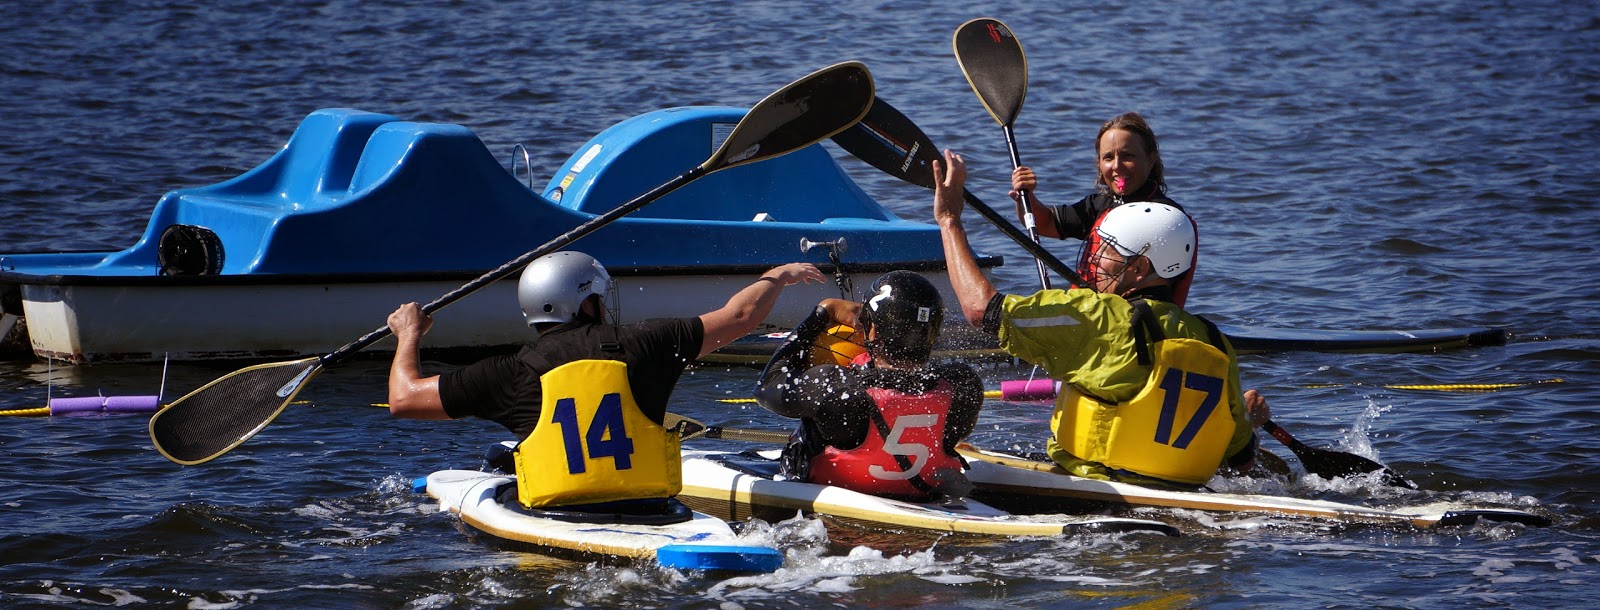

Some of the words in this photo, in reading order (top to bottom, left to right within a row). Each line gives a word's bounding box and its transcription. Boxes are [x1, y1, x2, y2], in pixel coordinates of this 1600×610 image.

[551, 393, 634, 474] 14
[868, 414, 939, 480] 5
[1154, 367, 1224, 450] 17
